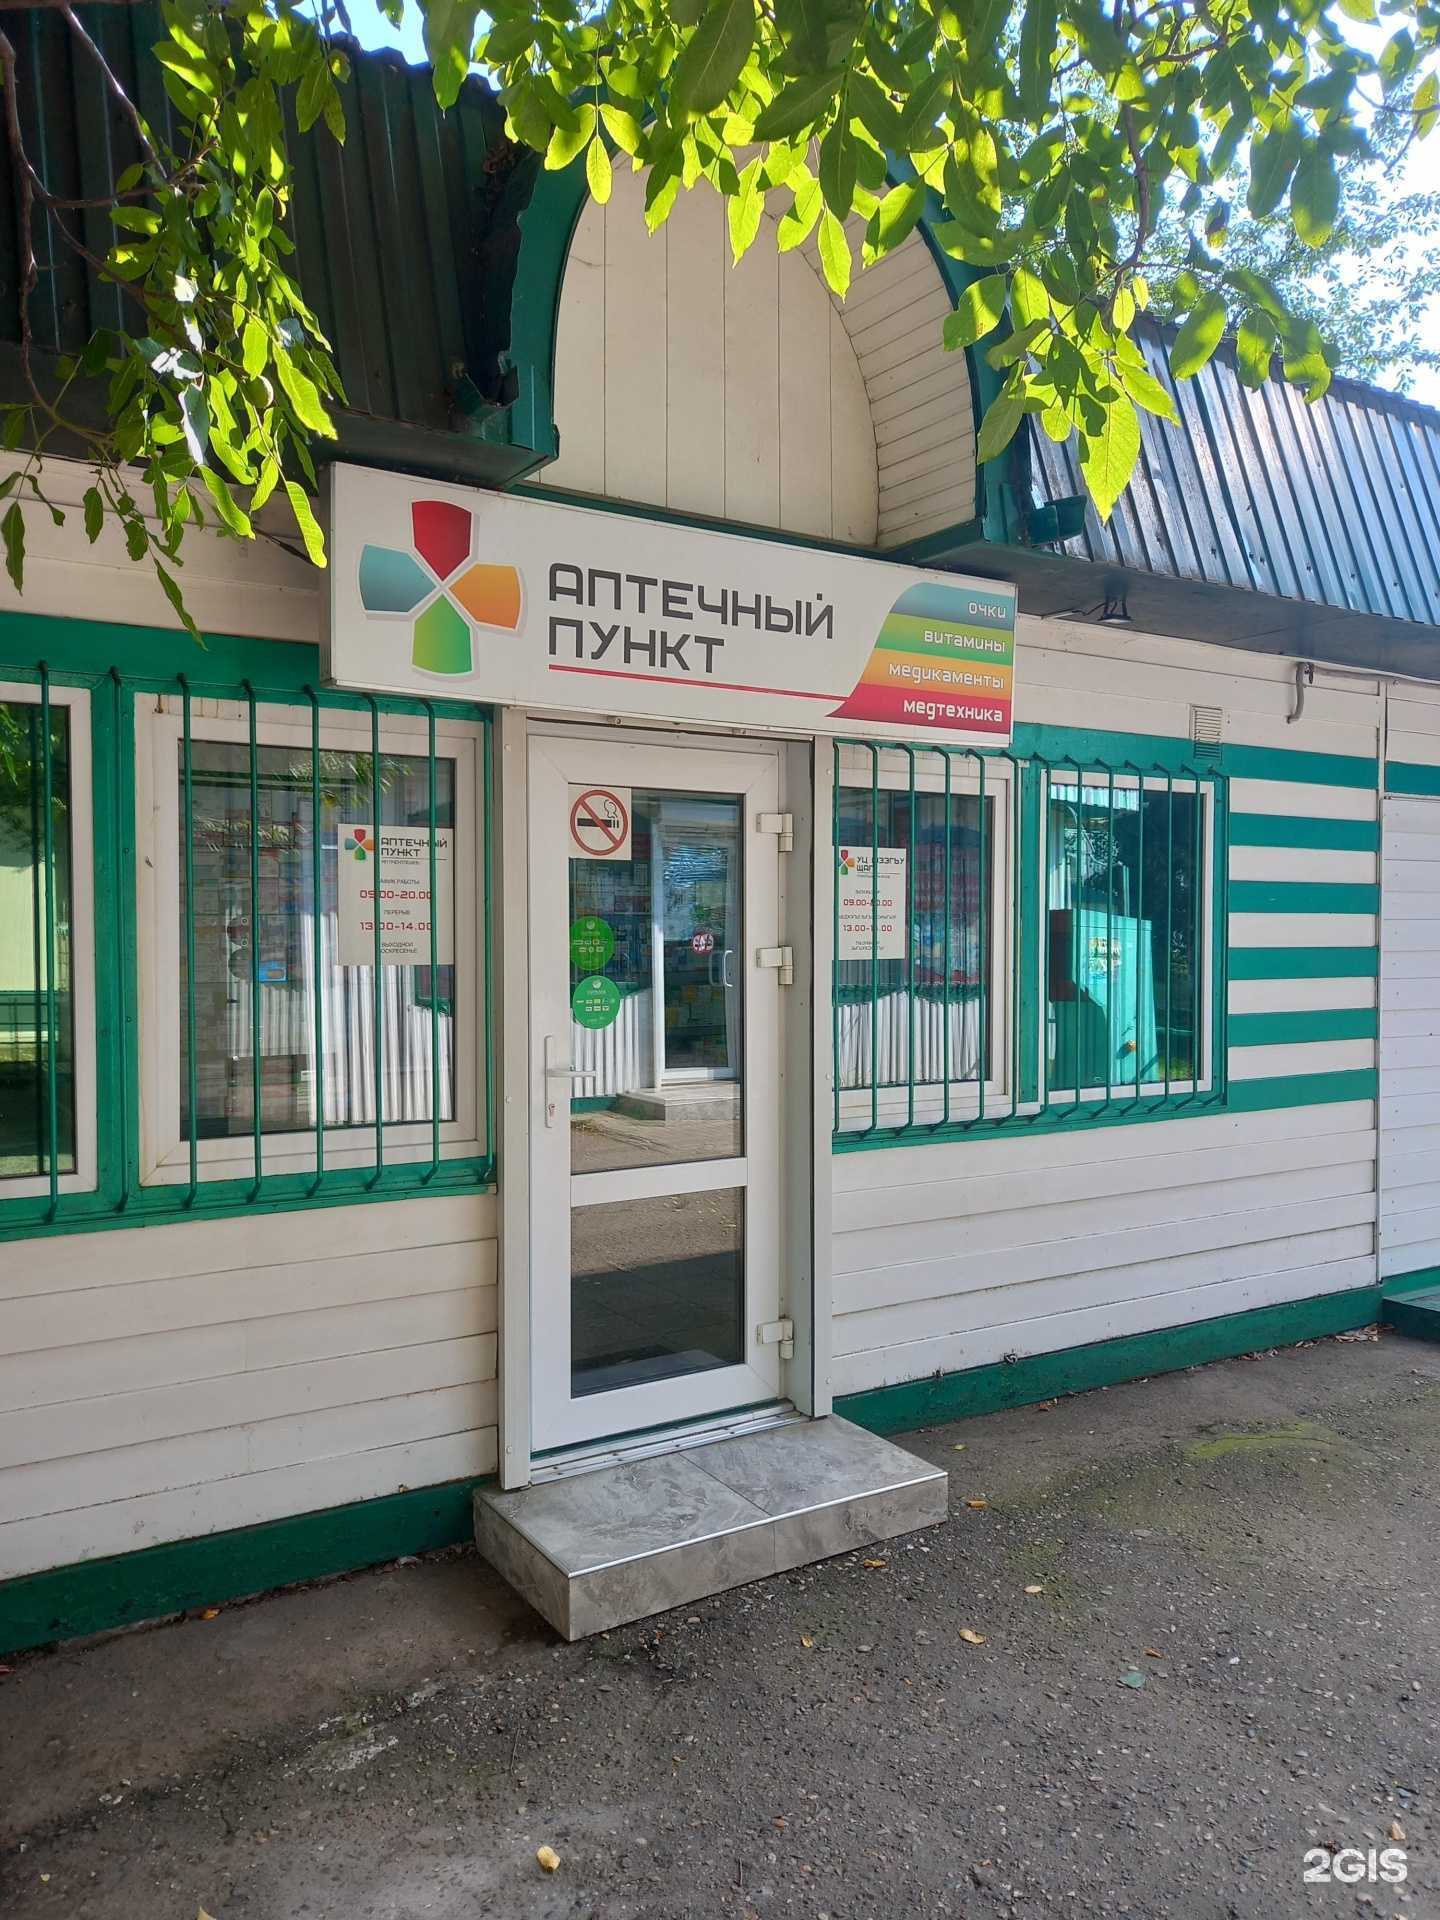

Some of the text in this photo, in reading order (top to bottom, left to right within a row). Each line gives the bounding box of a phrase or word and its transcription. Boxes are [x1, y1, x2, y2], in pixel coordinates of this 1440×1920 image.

[549, 563, 834, 640] АПТЕЧНЫЙ
[969, 602, 1007, 620] очки
[548, 616, 725, 673] ПУНКТ
[924, 630, 1006, 652] витамины
[889, 663, 1004, 689] медикаменты
[904, 700, 1003, 722] медтехника
[381, 848, 420, 857] ПУНКТ
